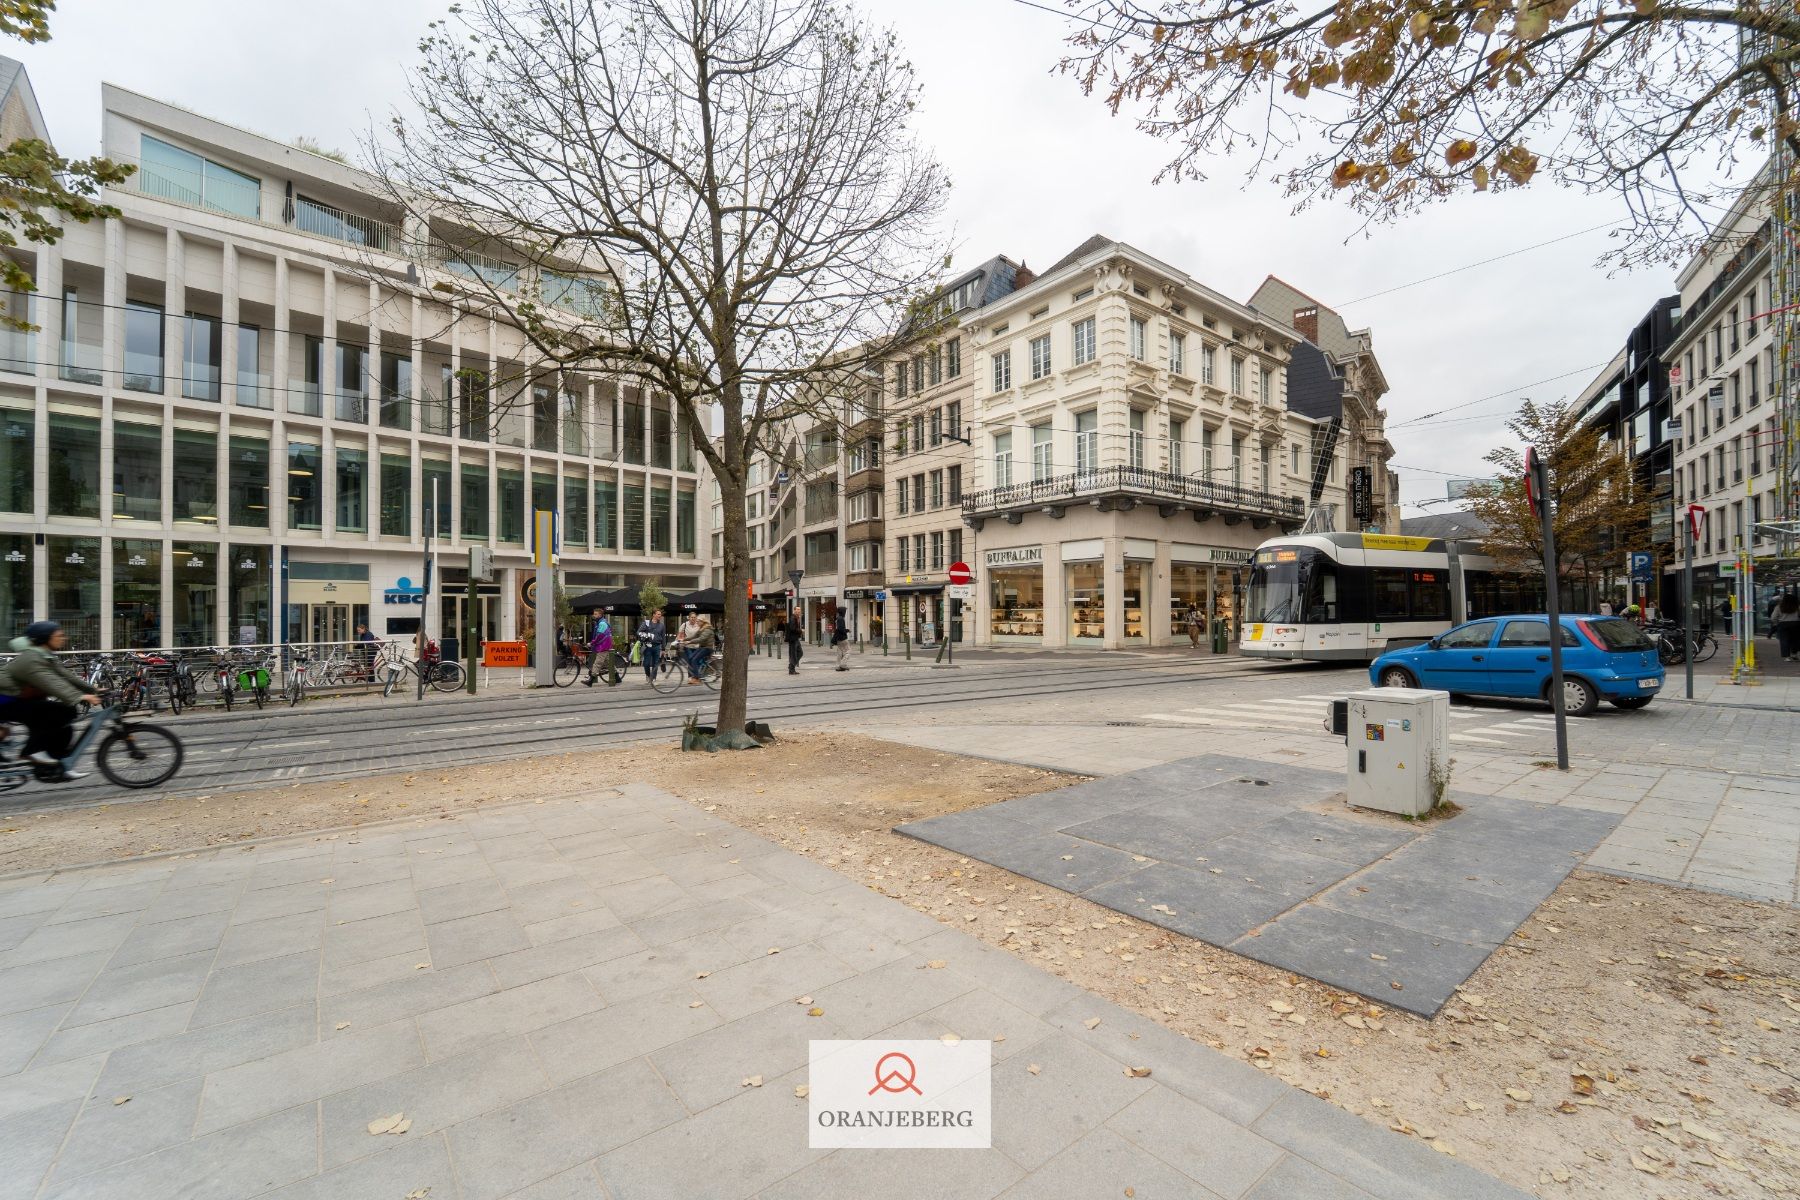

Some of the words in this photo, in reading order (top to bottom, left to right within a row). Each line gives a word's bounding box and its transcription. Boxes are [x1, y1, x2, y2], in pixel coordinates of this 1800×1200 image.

[986, 548, 1042, 563] BUFFALINI
[1634, 555, 1649, 569] P
[384, 594, 423, 604] KBC
